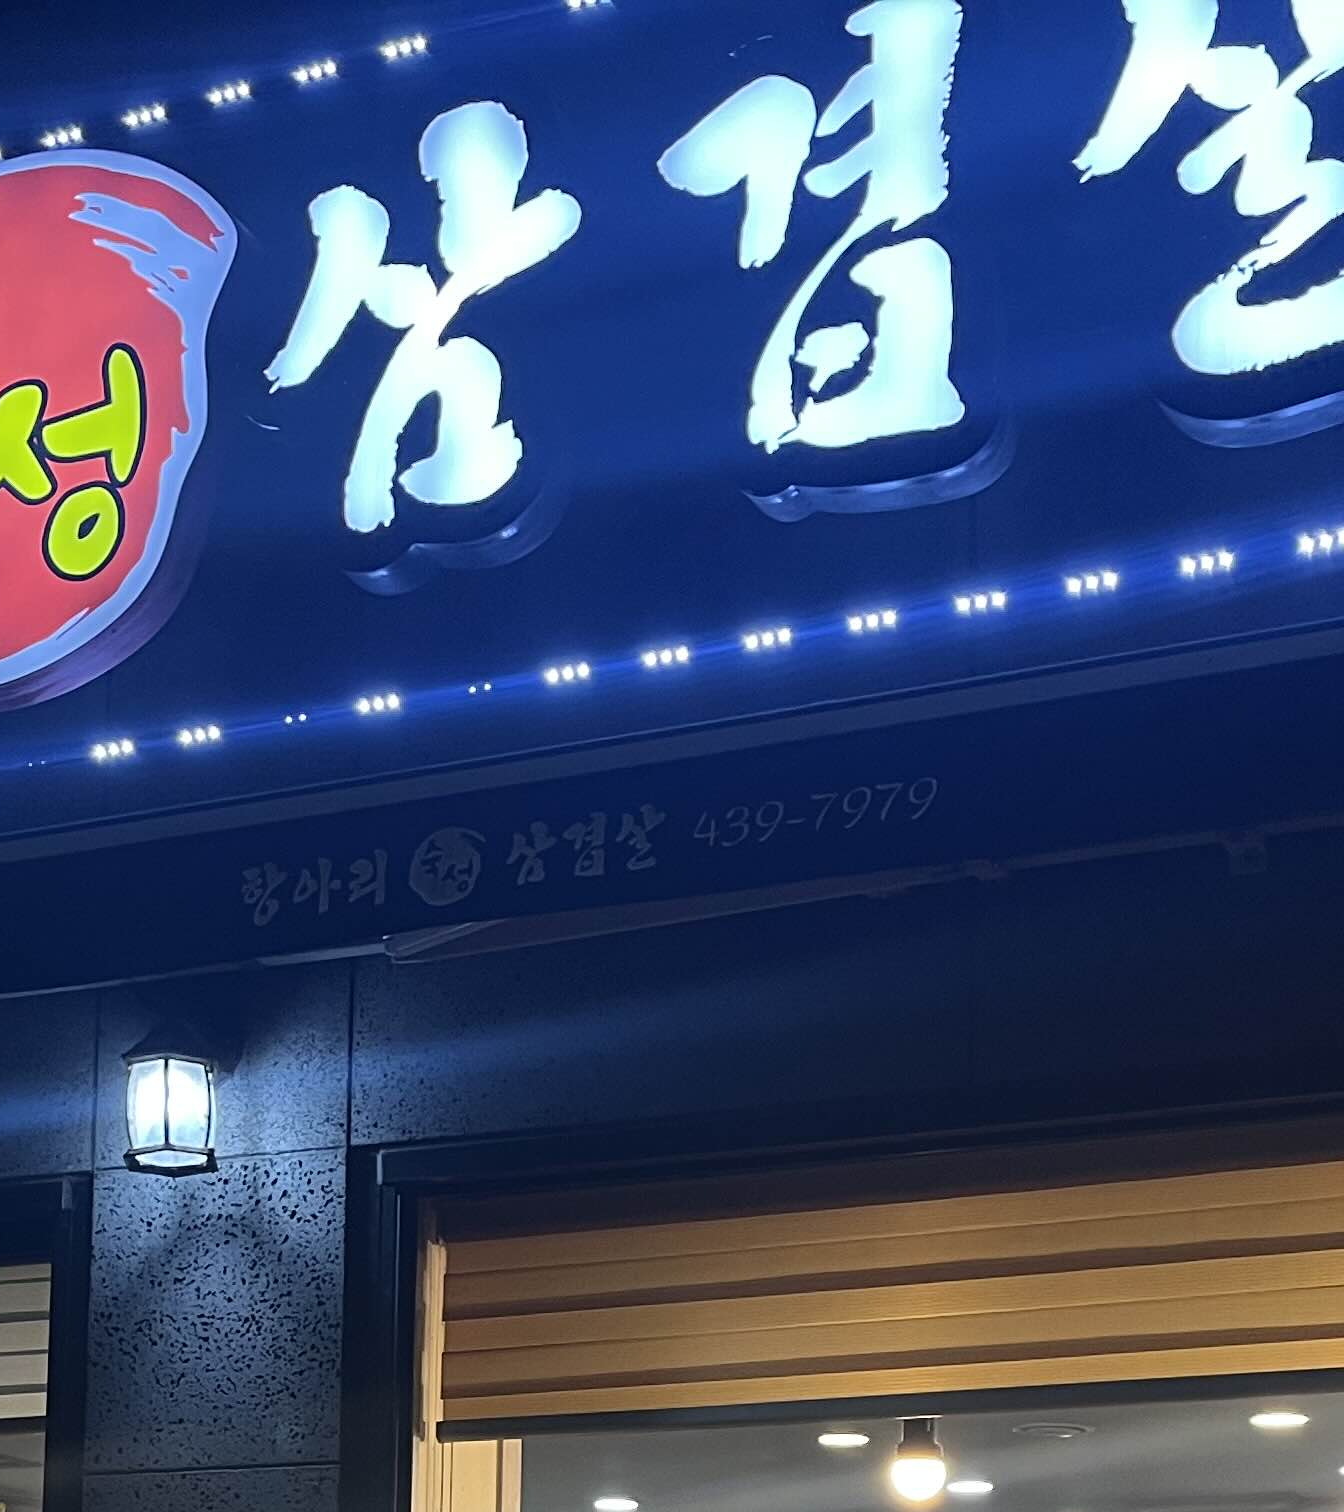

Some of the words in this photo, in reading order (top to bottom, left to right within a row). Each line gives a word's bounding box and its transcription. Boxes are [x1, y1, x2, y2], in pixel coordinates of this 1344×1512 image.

[240, 847, 389, 926] 항아리
[506, 803, 668, 887] 삼겹살
[692, 776, 940, 849] 439-7979
